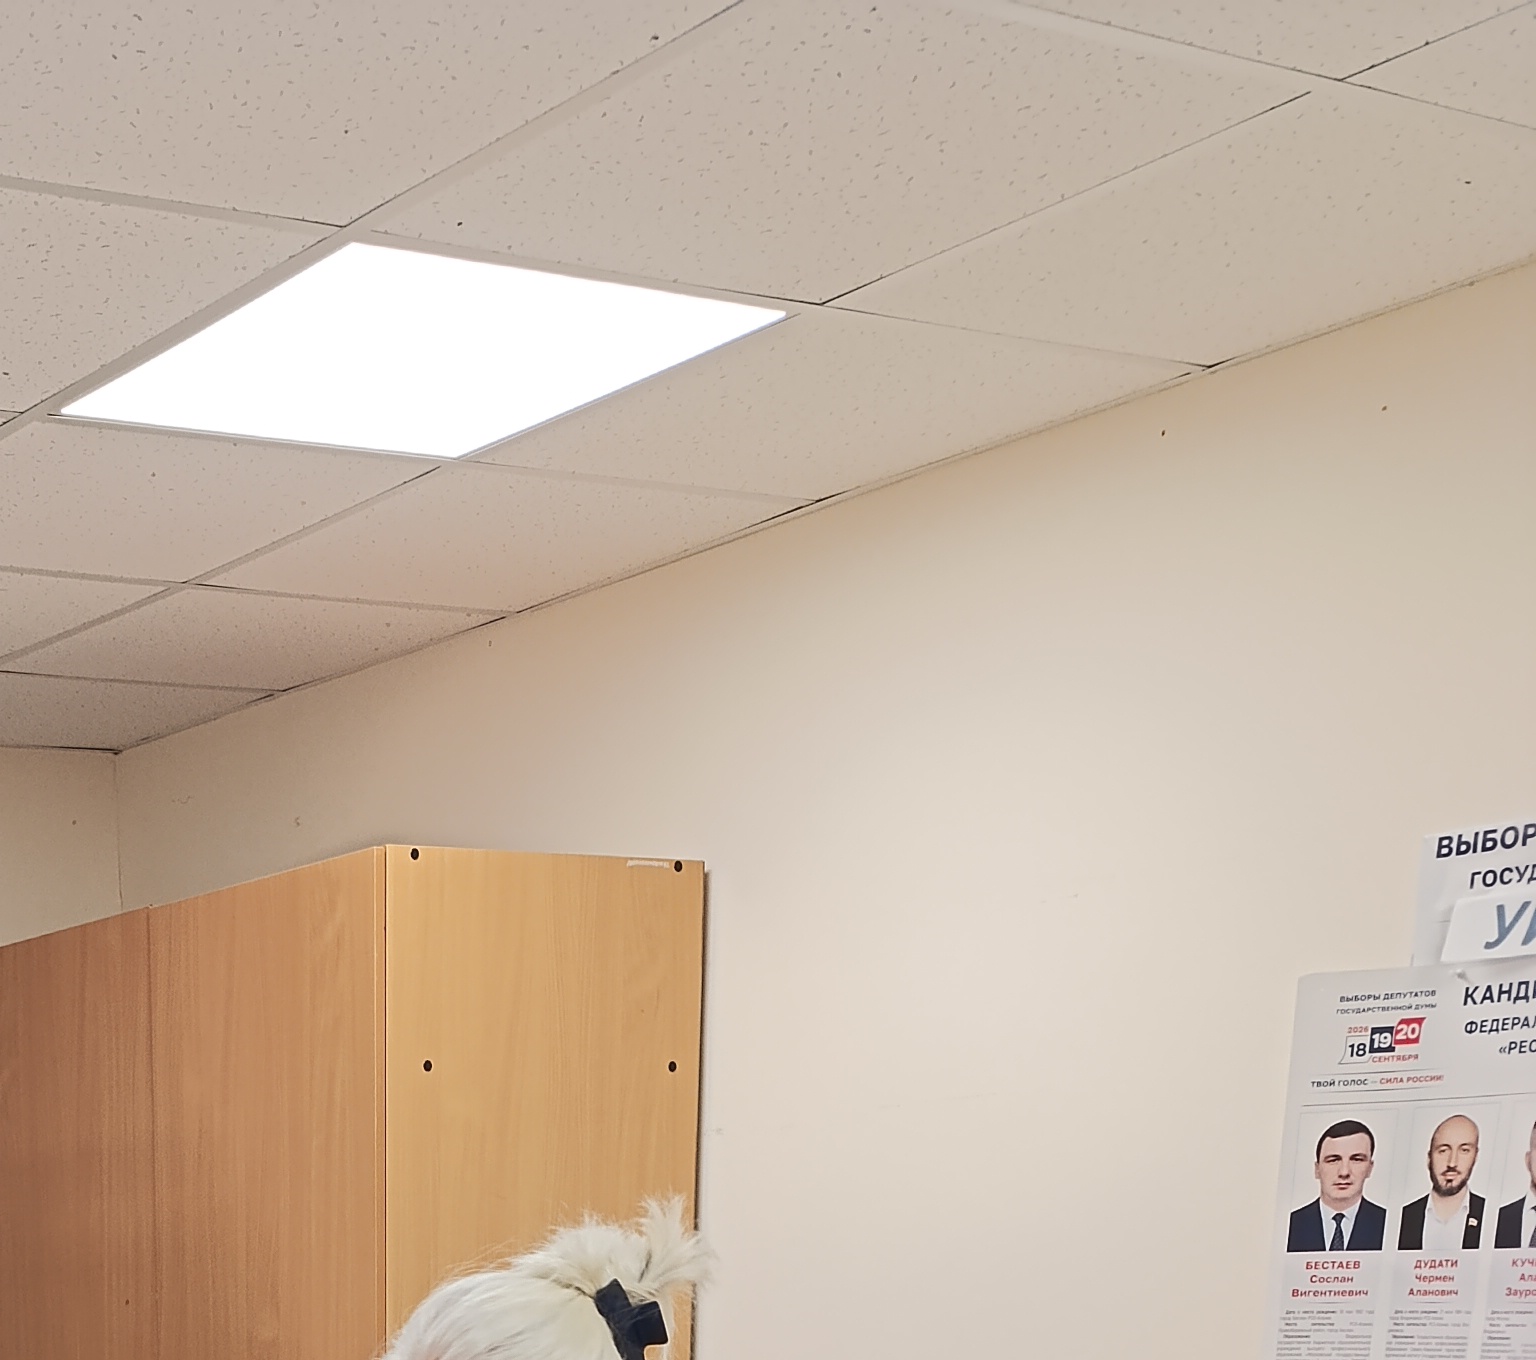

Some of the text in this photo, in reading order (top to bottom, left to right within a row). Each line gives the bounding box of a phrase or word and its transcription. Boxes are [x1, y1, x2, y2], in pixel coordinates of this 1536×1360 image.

[1436, 823, 1536, 858] ВЫБОР
[1339, 989, 1437, 1003] ВЫБОРЫ ДЕПУТАТОВ
[1463, 980, 1536, 1006] КАНД
[1336, 1003, 1437, 1015] ГОСУДАРСТВЕННОЙ ДУМЫ
[1464, 1015, 1536, 1035] ФЕДЕРА
[1348, 1023, 1420, 1058] 18 19 20
[1371, 1054, 1419, 1064] СЕНТЯБРЯ
[1310, 1078, 1336, 1088] ТВОЙ
[1338, 1078, 1369, 1087] ГОЛОС
[1380, 1077, 1404, 1085] СИЛА
[1305, 1260, 1361, 1270] БЕСТАЕВ
[1414, 1259, 1459, 1270] ДУДАТИ
[1310, 1274, 1354, 1284] Сослан
[1415, 1274, 1455, 1284] Чермен
[1291, 1288, 1369, 1298] Вигентиевич
[1408, 1288, 1459, 1297] Аланович
